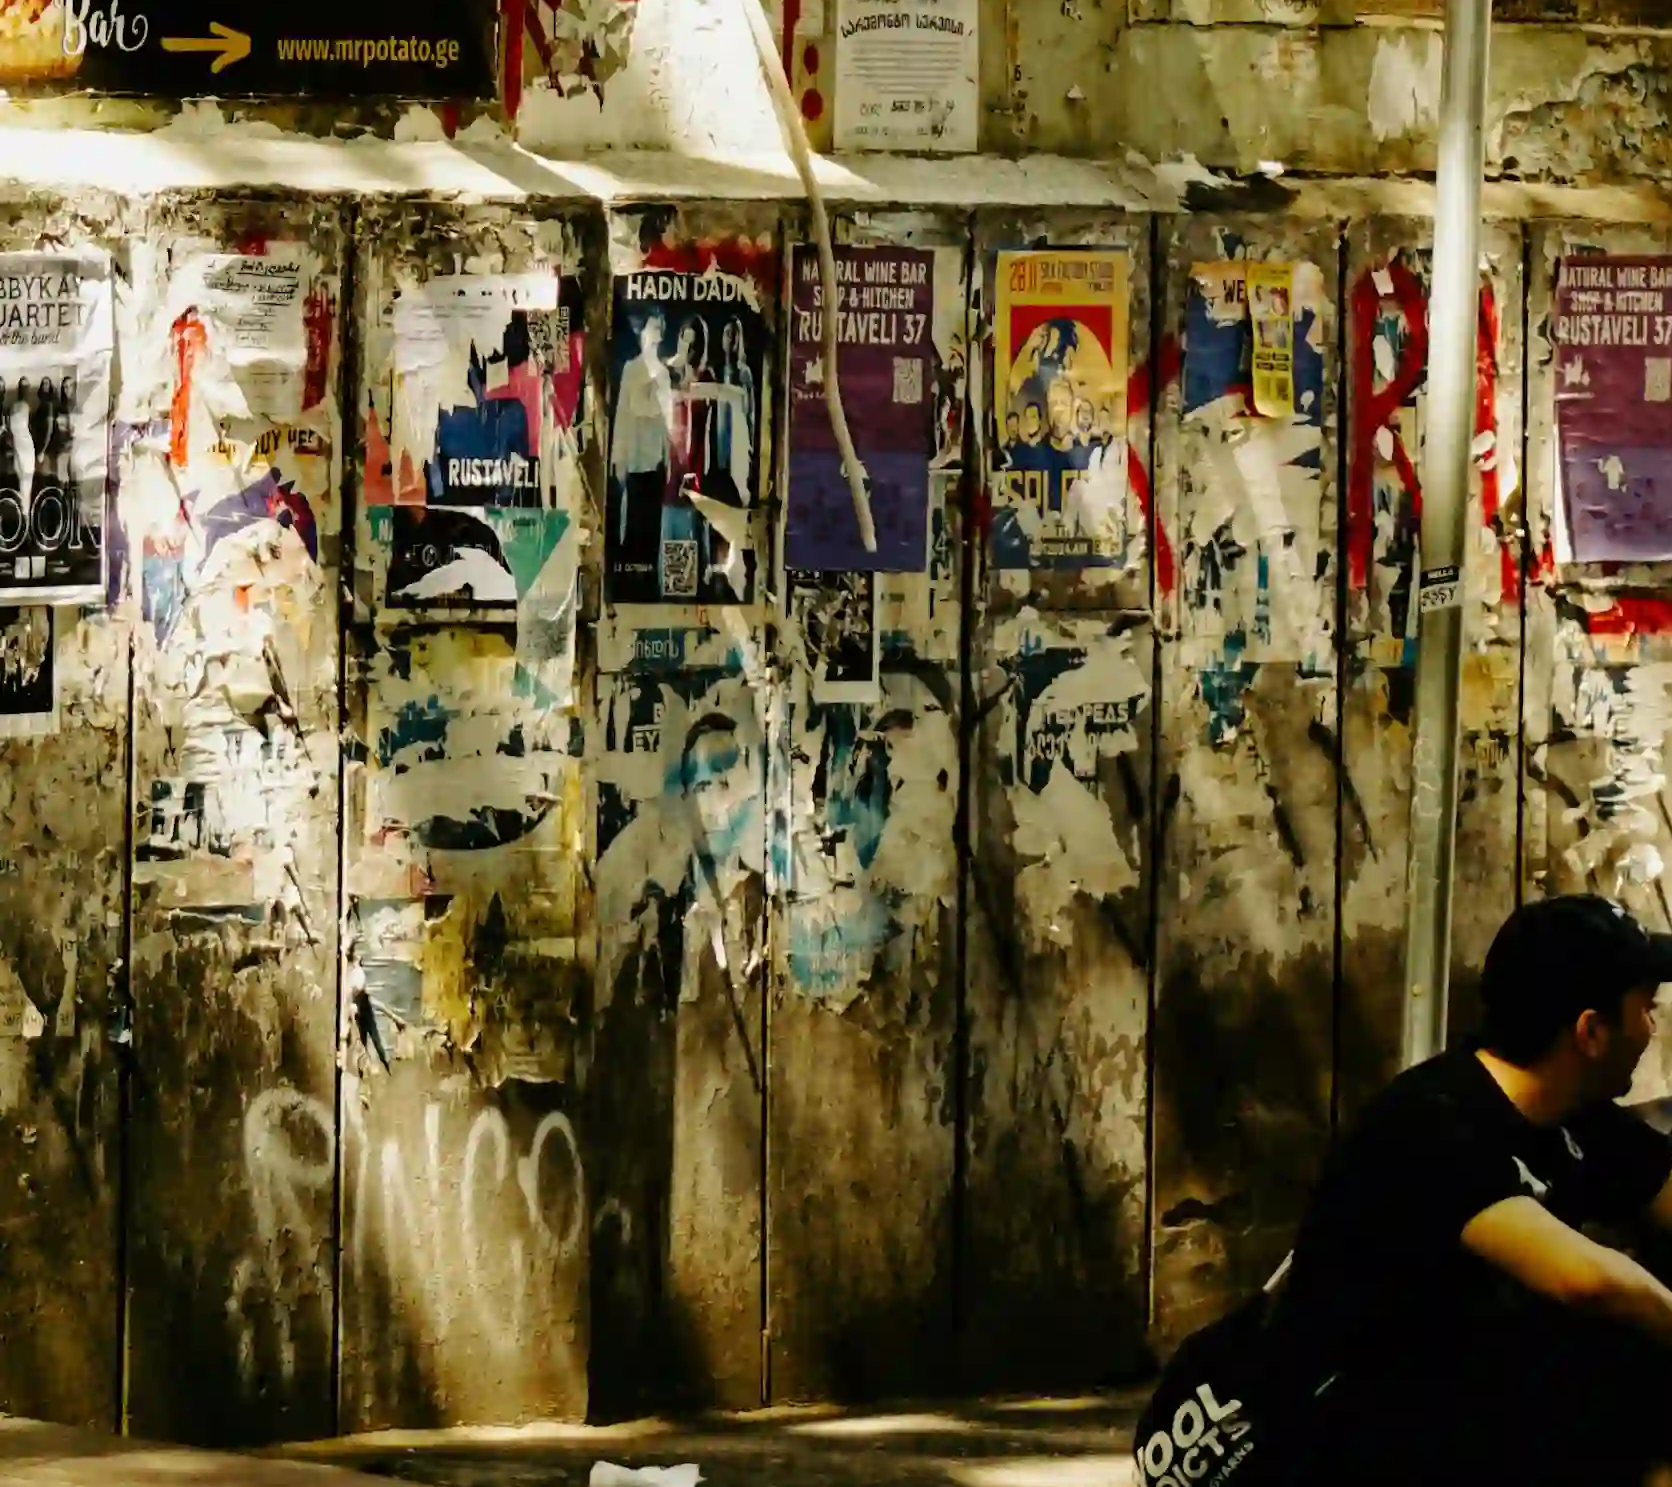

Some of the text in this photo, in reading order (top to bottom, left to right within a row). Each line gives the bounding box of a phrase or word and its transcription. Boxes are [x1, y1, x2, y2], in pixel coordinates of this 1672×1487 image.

[277, 34, 460, 69] www.mrpotato.ge
[802, 259, 927, 285] NARAL WINE BAR
[1616, 266, 1648, 289] WINE
[627, 274, 688, 301] HADN
[812, 286, 846, 308] SP
[798, 310, 928, 345] RUTAVELI 37
[1557, 314, 1648, 346] RUSTAVELI
[448, 457, 540, 488] RUSTAVELI
